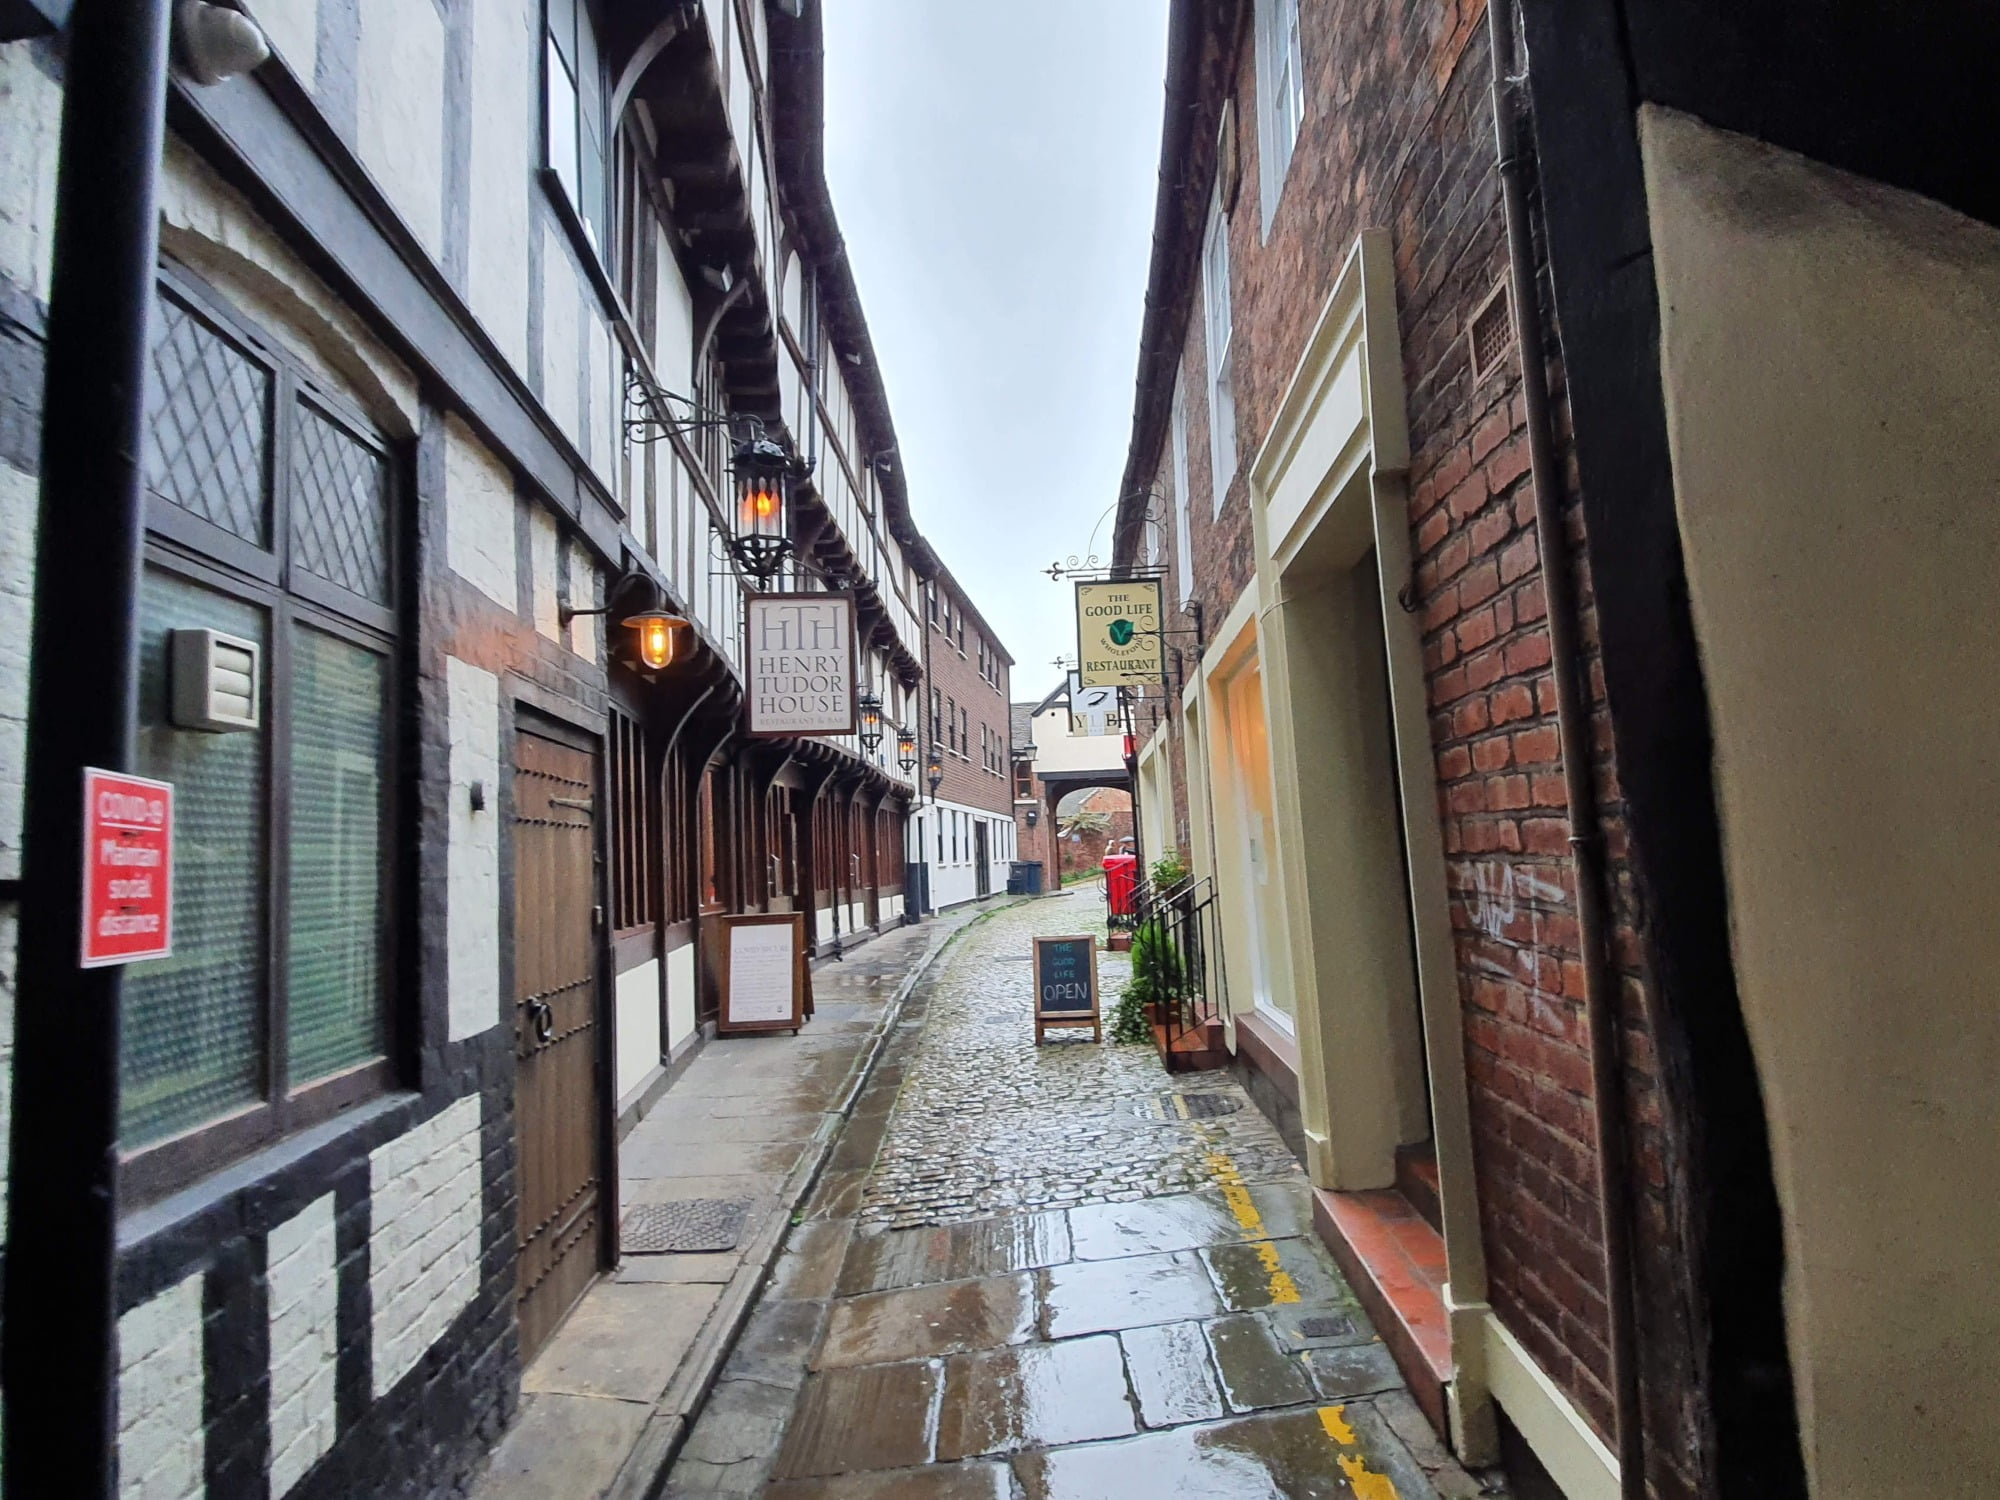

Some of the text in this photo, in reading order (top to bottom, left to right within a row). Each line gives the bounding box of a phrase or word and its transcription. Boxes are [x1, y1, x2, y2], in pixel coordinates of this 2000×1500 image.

[1107, 594, 1130, 602] THE
[1085, 603, 1153, 617] GOOD LIFE
[759, 655, 844, 674] HENRY
[1086, 658, 1158, 672] RESTAURANT
[758, 675, 845, 694] TUDOR
[759, 695, 845, 714] HOUSE
[108, 872, 152, 899] social
[98, 909, 160, 937] distance
[1052, 943, 1073, 953] THE
[1054, 970, 1075, 979] LIFE
[1043, 982, 1088, 1001] OPEN
